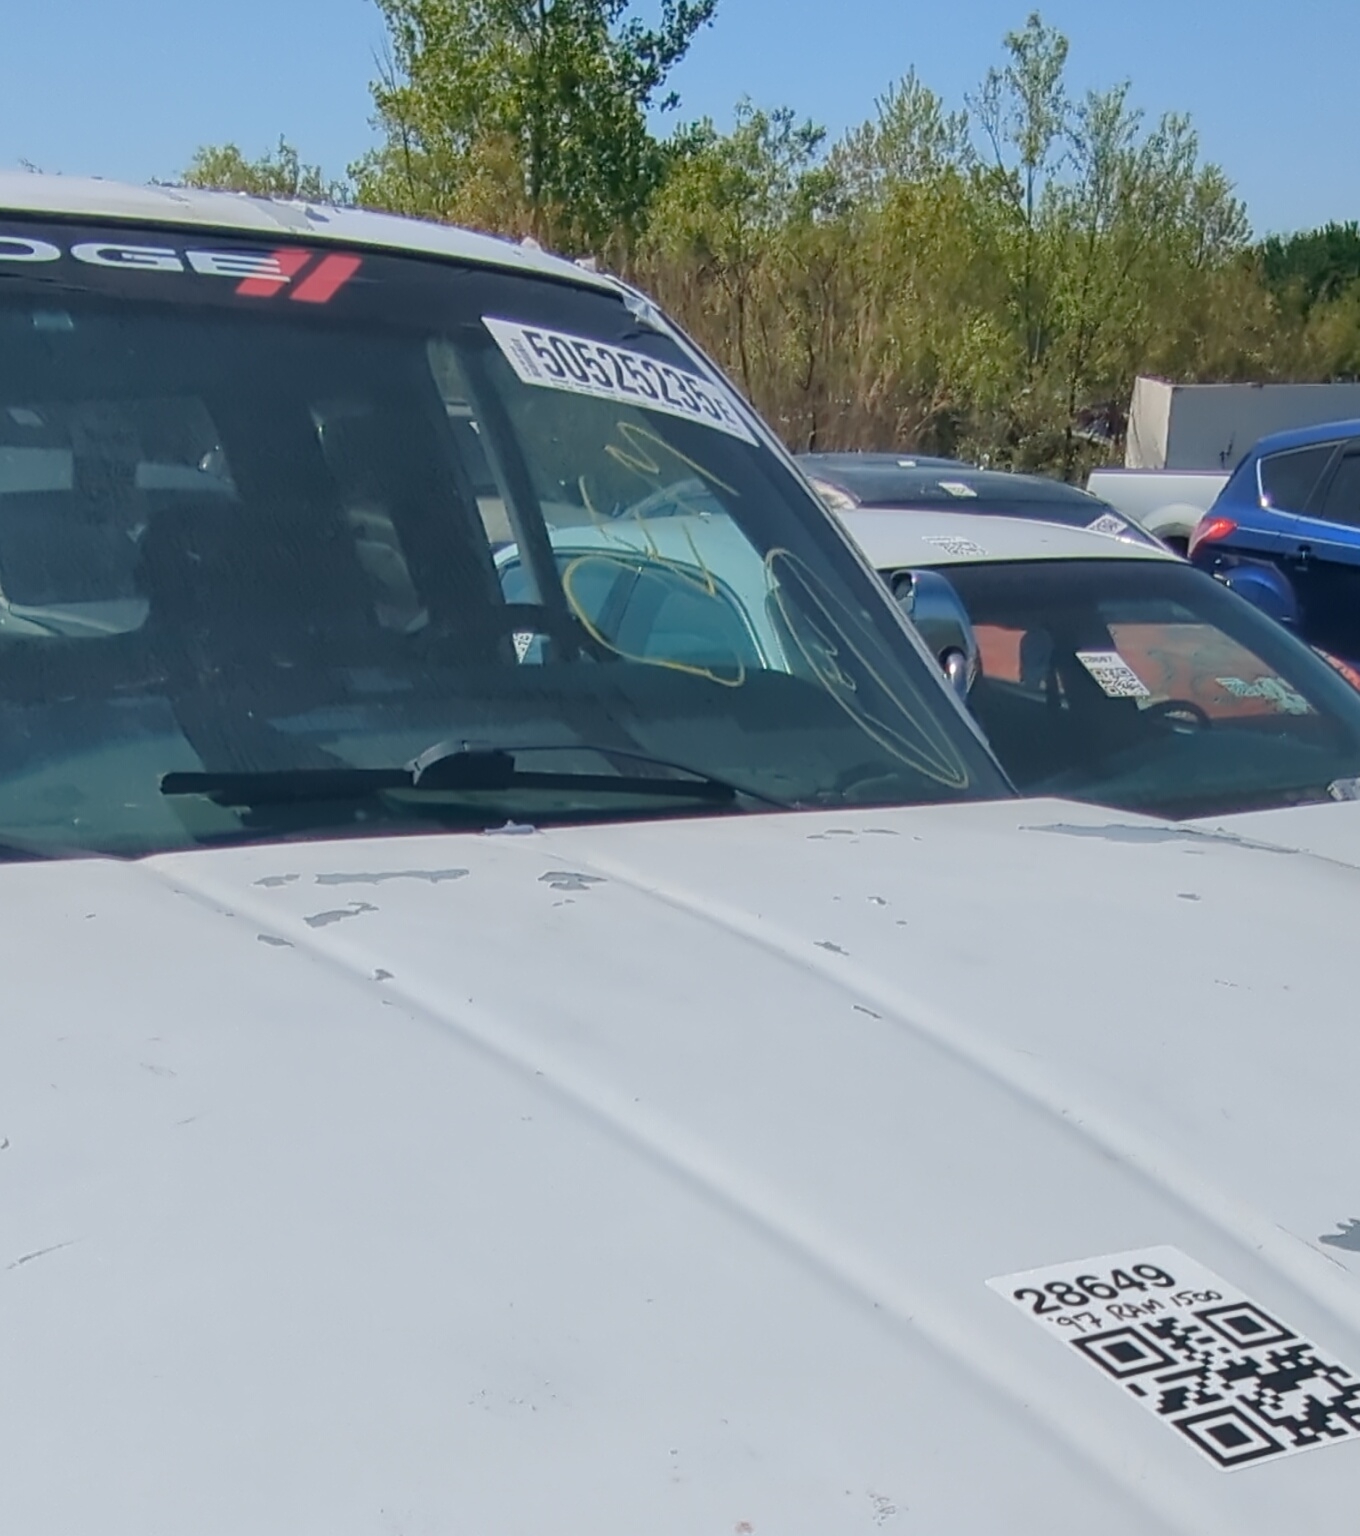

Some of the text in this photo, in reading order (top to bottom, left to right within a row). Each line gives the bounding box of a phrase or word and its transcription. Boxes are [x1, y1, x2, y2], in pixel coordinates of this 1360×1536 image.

[521, 330, 721, 419] 50525235
[1014, 1263, 1177, 1315] 28649
[1047, 1288, 1224, 1334] '97 RAM 1500
